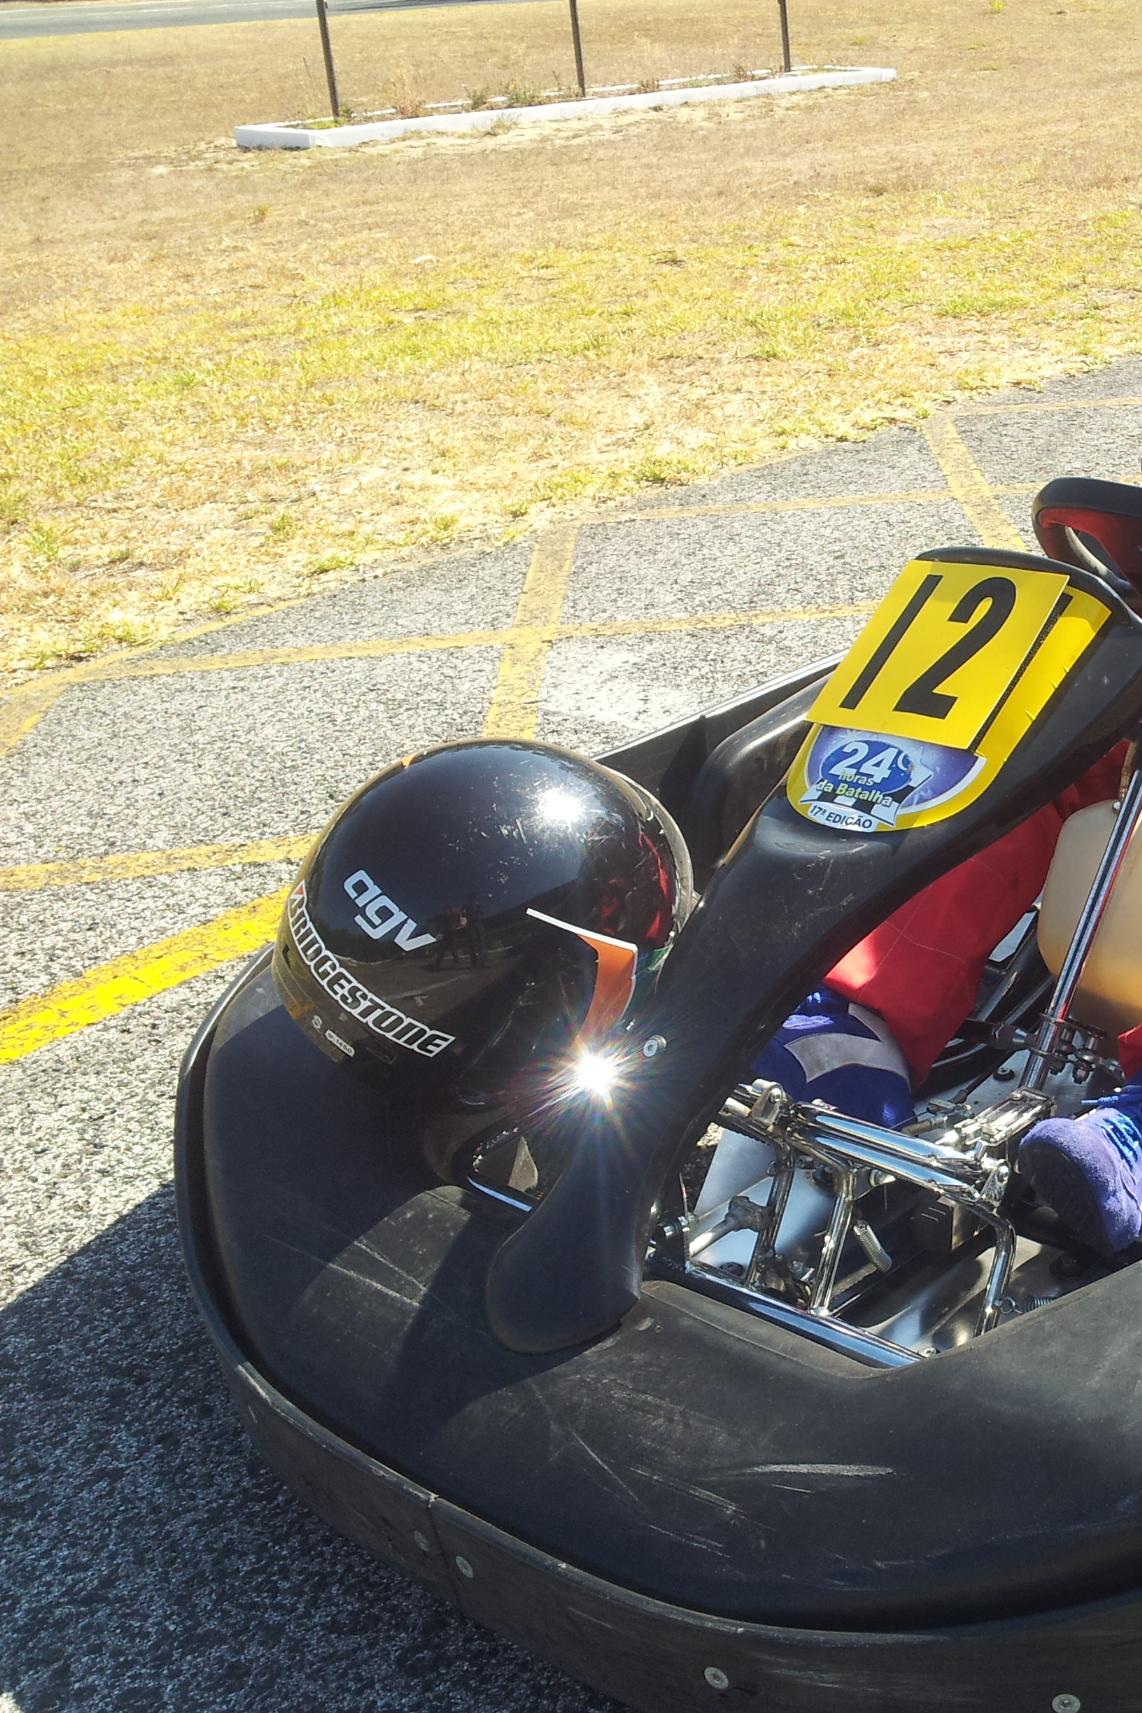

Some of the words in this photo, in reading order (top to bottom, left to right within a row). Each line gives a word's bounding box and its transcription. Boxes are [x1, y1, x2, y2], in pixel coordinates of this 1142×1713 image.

[838, 573, 1017, 720] 12
[828, 741, 899, 784] 24
[838, 770, 875, 786] horas
[816, 779, 834, 793] da
[835, 782, 893, 808] Batalha
[288, 880, 456, 1058] BRIDGESTONE
